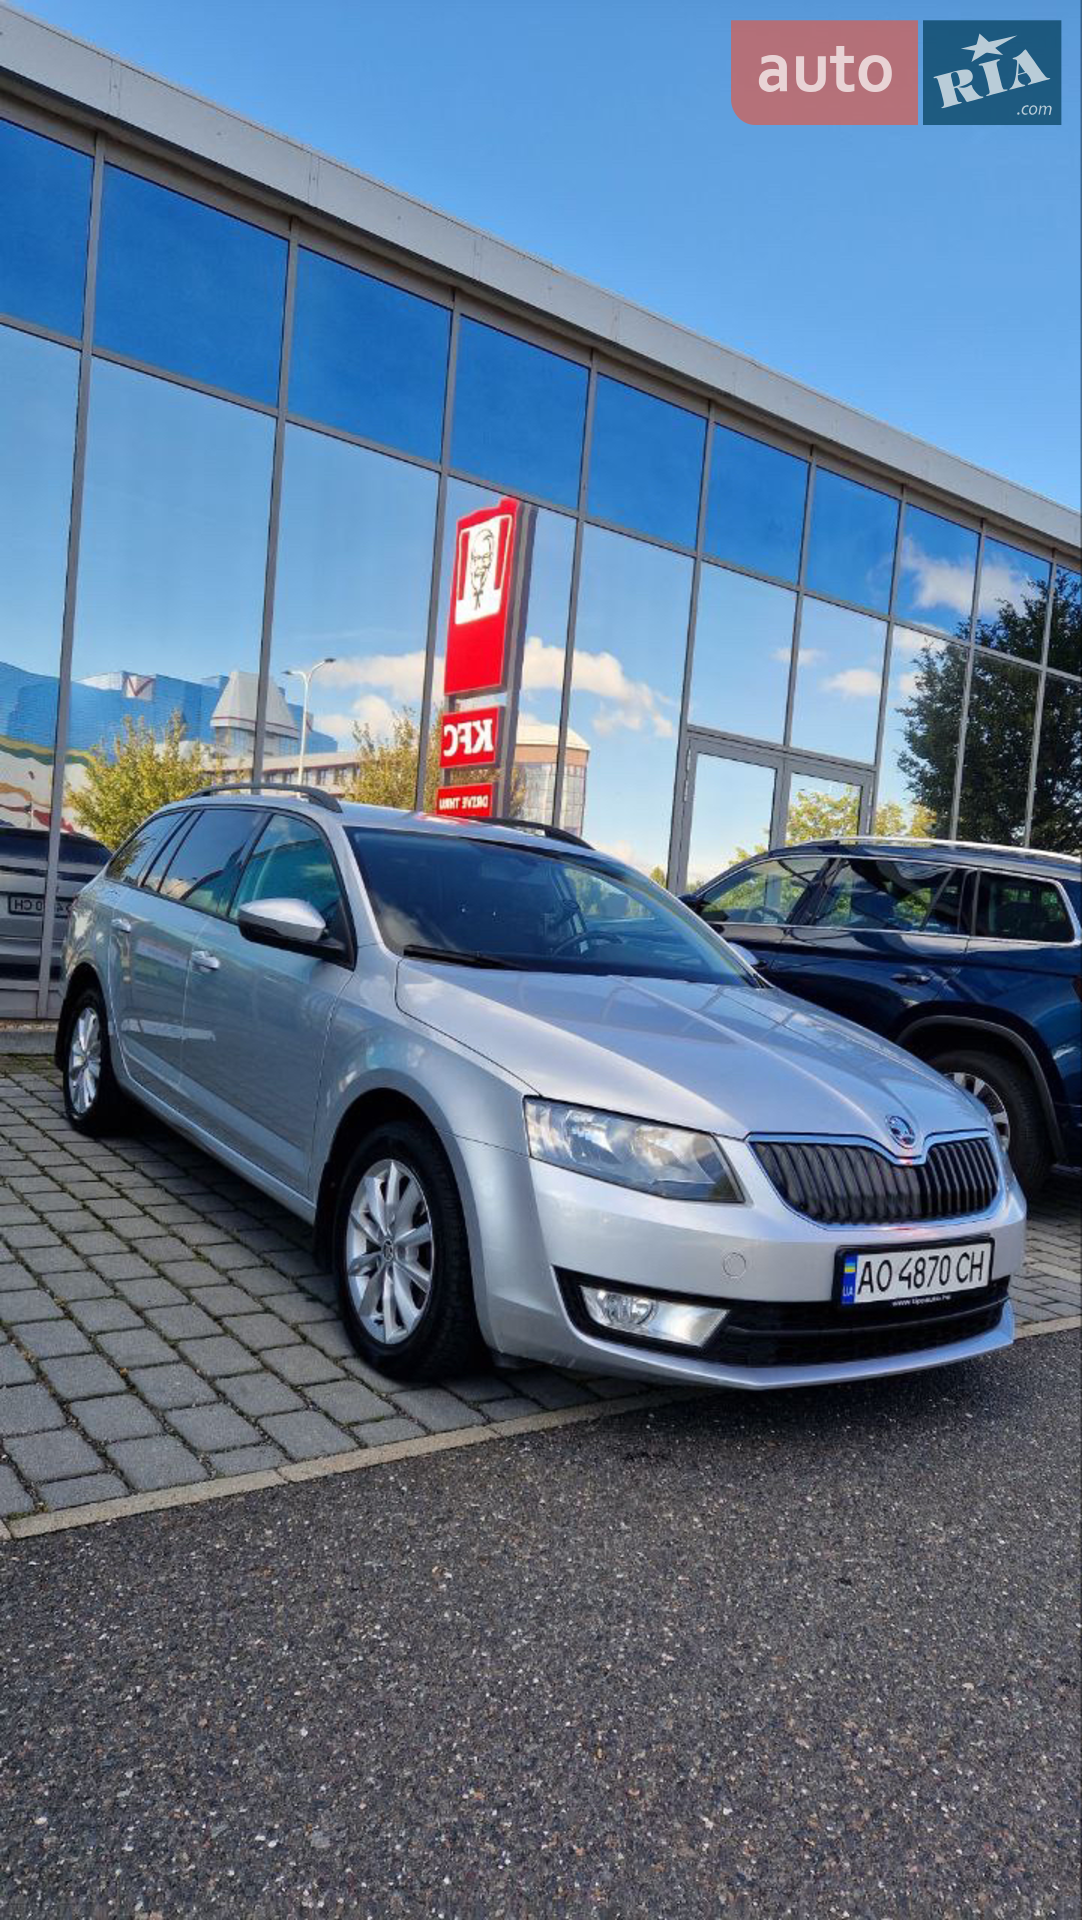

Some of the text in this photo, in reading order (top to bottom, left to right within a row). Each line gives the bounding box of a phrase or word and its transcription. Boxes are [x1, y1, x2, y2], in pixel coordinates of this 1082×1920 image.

[857, 1250, 985, 1295] AO 4870 CH
